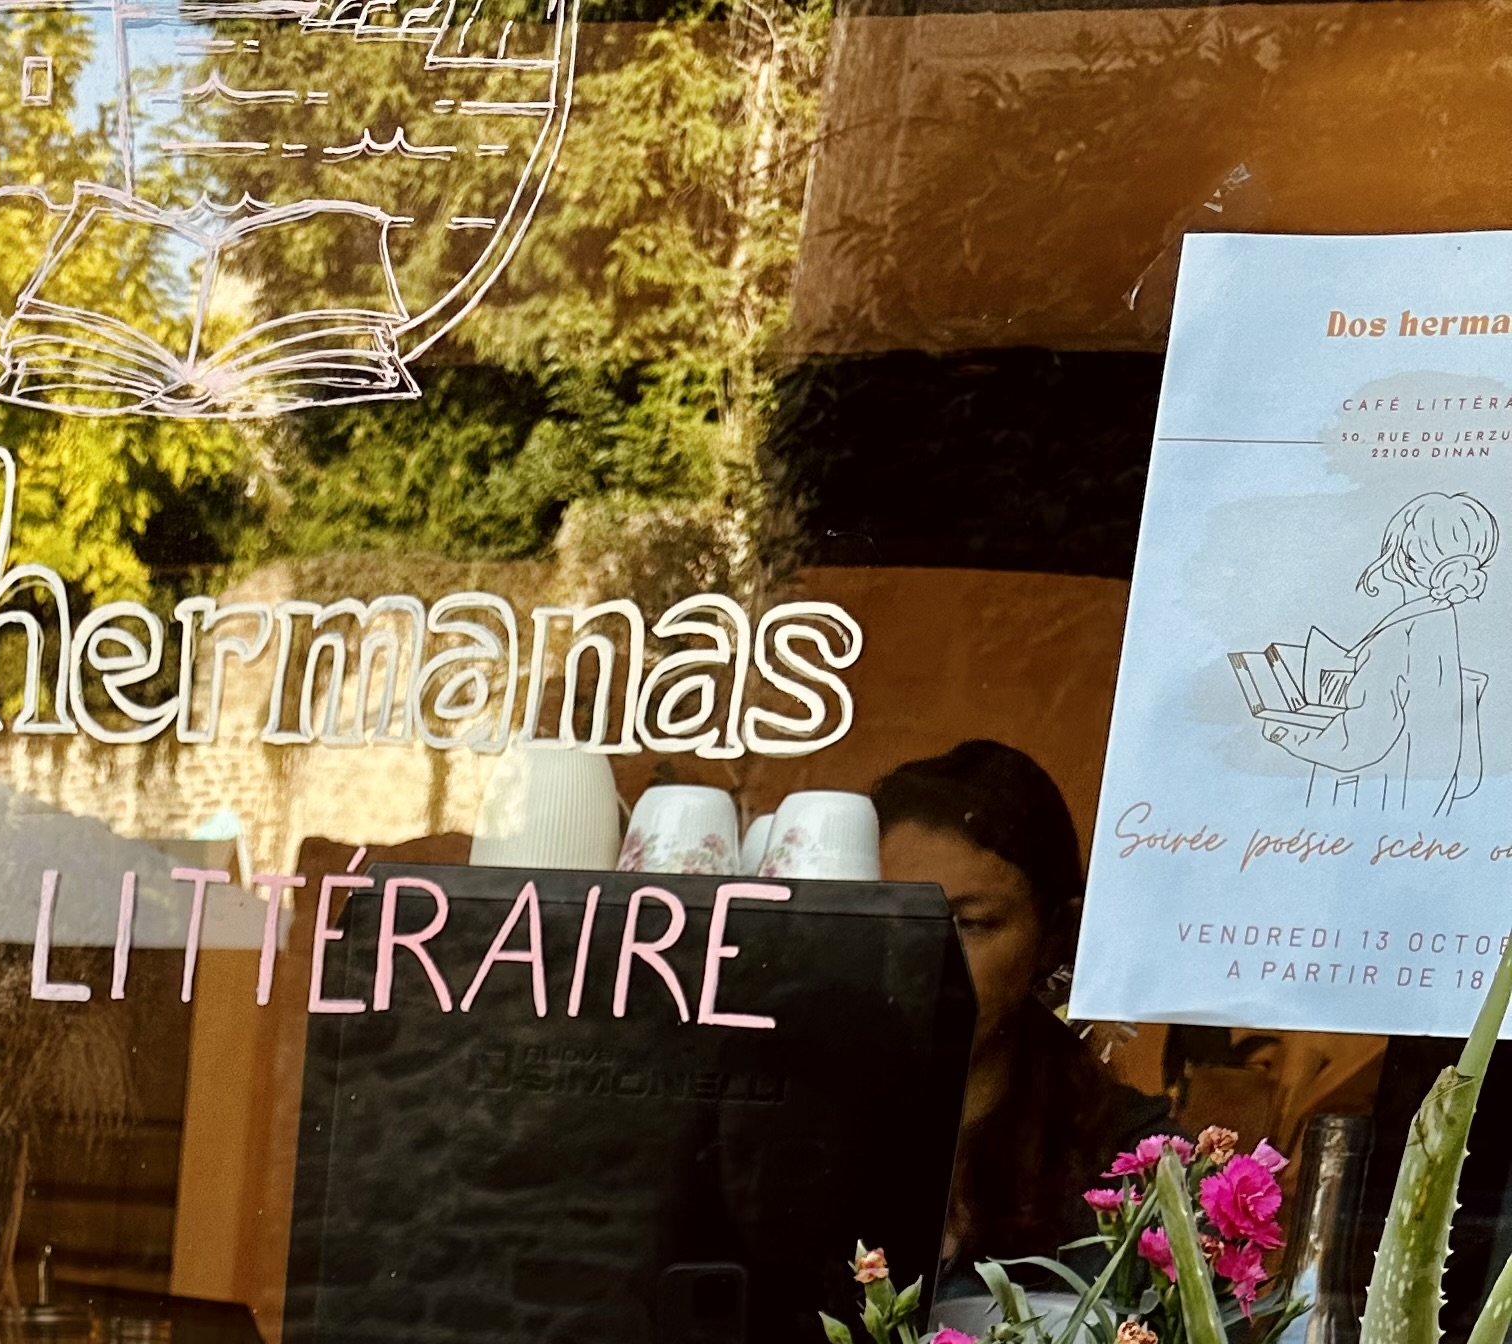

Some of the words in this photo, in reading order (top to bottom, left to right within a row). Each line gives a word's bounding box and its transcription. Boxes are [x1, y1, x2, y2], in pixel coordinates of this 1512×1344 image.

[1326, 310, 1388, 338] Dos
[1398, 309, 1512, 338] herma
[1342, 396, 1401, 411] CAFÉ
[1377, 431, 1410, 442] RUE
[1421, 431, 1444, 442] DU
[1371, 447, 1421, 458] 22100
[1431, 447, 1490, 458] DINAN
[1114, 801, 1228, 859] Soirée
[1240, 828, 1355, 873] poésie
[1369, 831, 1470, 866] scène
[30, 847, 792, 1029] LITTÉRAIRE
[1178, 922, 1341, 949] VENDREDI
[1361, 930, 1390, 951] 13
[1226, 960, 1241, 979] A
[1260, 960, 1380, 985] PARTIR
[1397, 966, 1436, 988] DE
